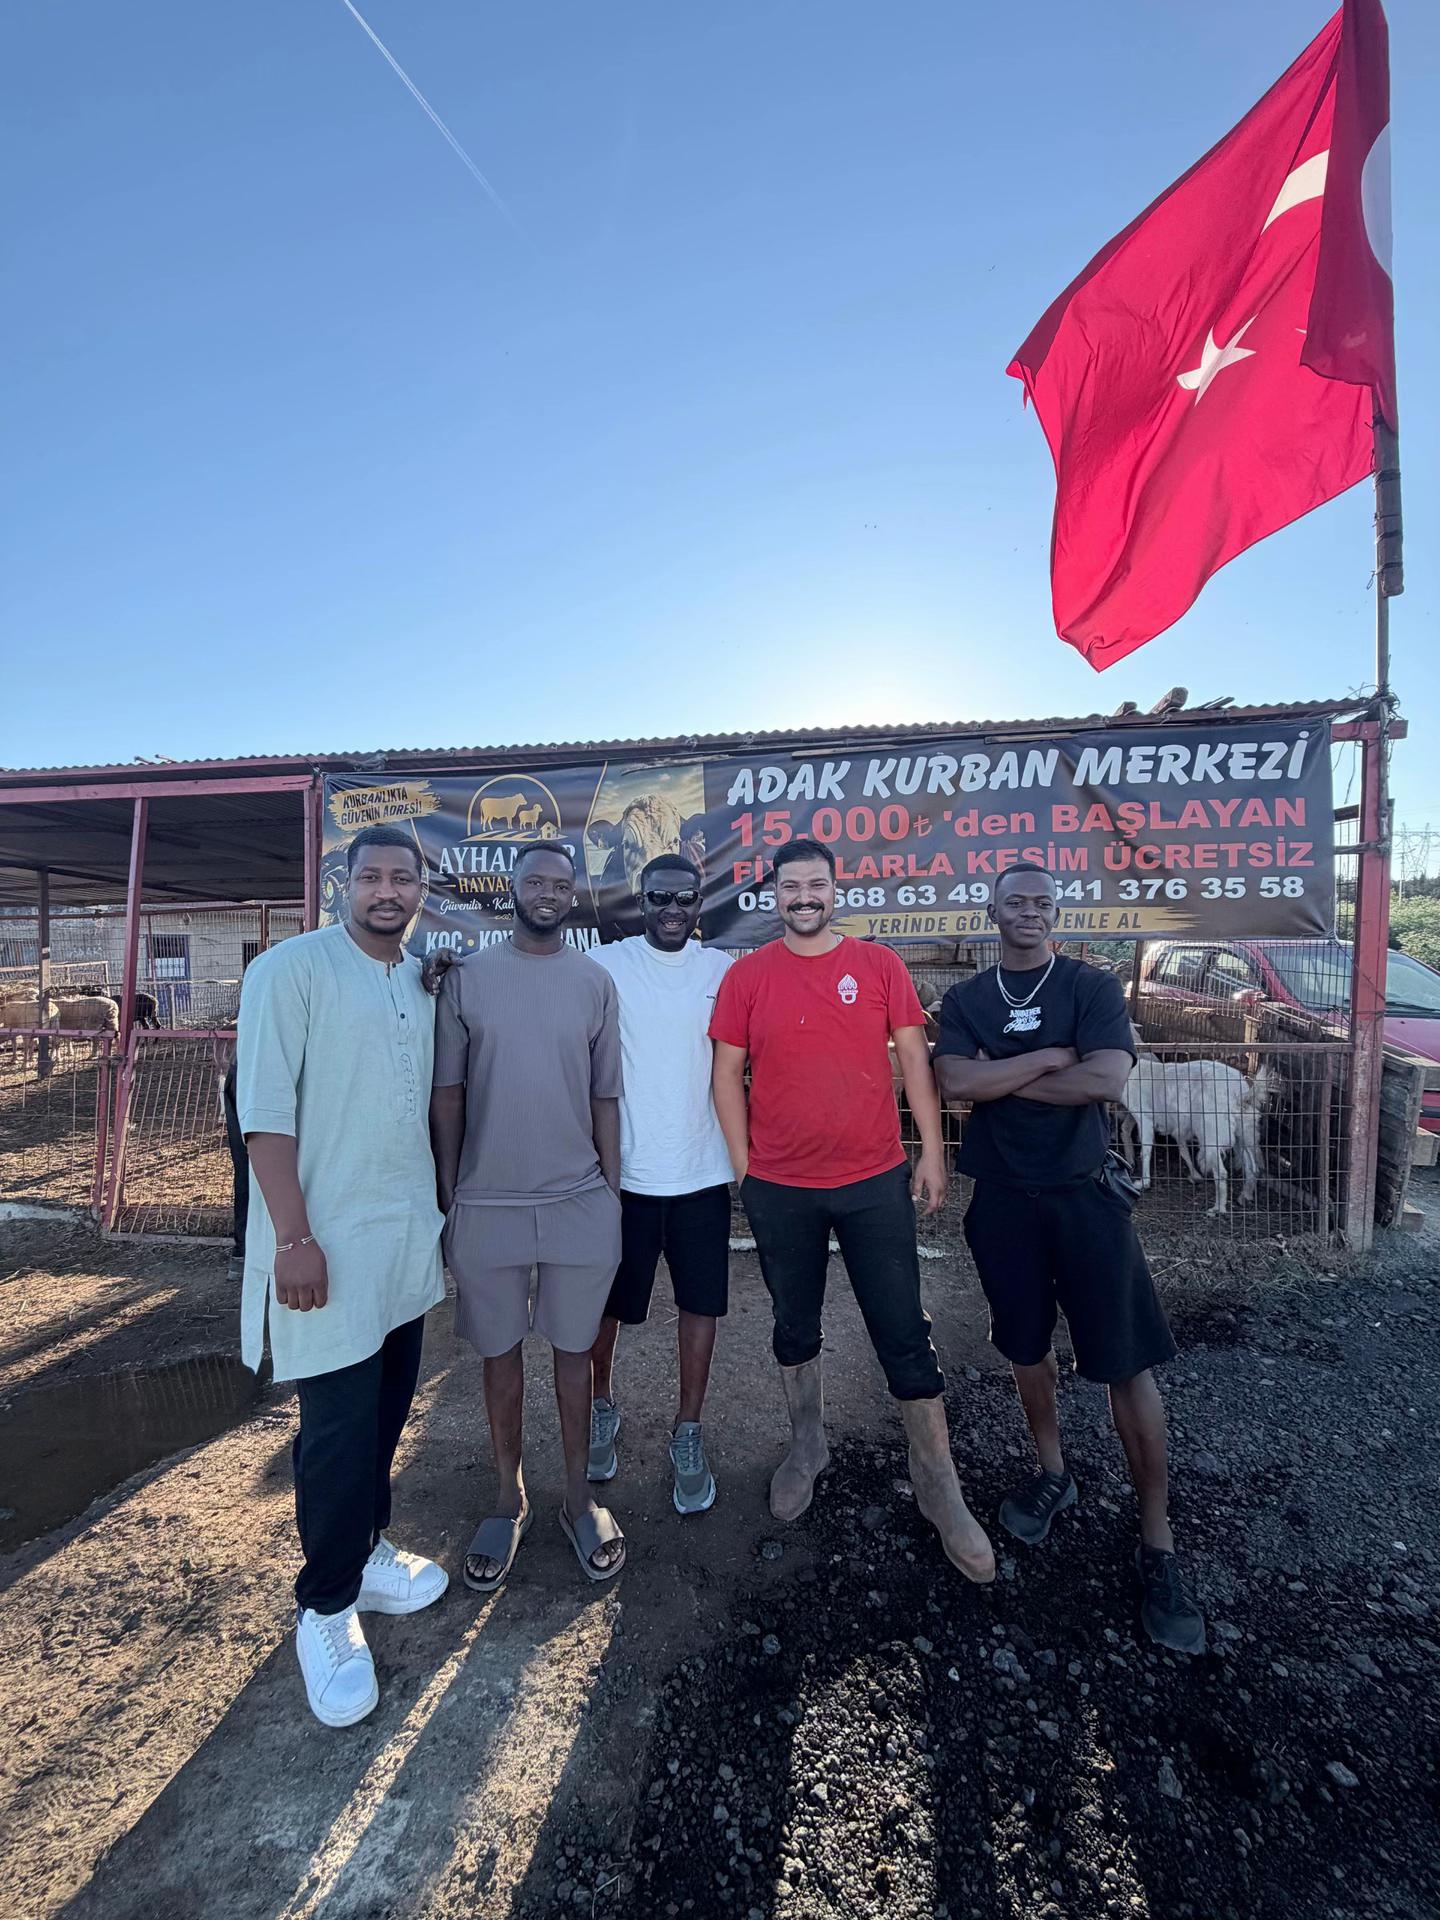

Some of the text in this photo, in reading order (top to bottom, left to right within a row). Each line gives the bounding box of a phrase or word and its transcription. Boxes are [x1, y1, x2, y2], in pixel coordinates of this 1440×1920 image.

[727, 731, 1310, 806] ADAK KURBAN MERKEZİ
[342, 786, 409, 810] KURBANLIKTA
[340, 798, 422, 826] GÜVENİN ADRESİ!
[1051, 797, 1306, 840] BAŞLAYAN
[733, 852, 955, 885] FİLARLA
[1103, 836, 1315, 872] ÜCRETSİZ
[897, 884, 938, 906] 63
[947, 882, 990, 904] 49
[1118, 878, 1188, 901] 376
[1200, 876, 1247, 899] 35
[1259, 875, 1306, 899] 58
[439, 897, 483, 916] Güvenilir
[867, 914, 948, 934] YERİNDE
[1116, 911, 1143, 929] AL
